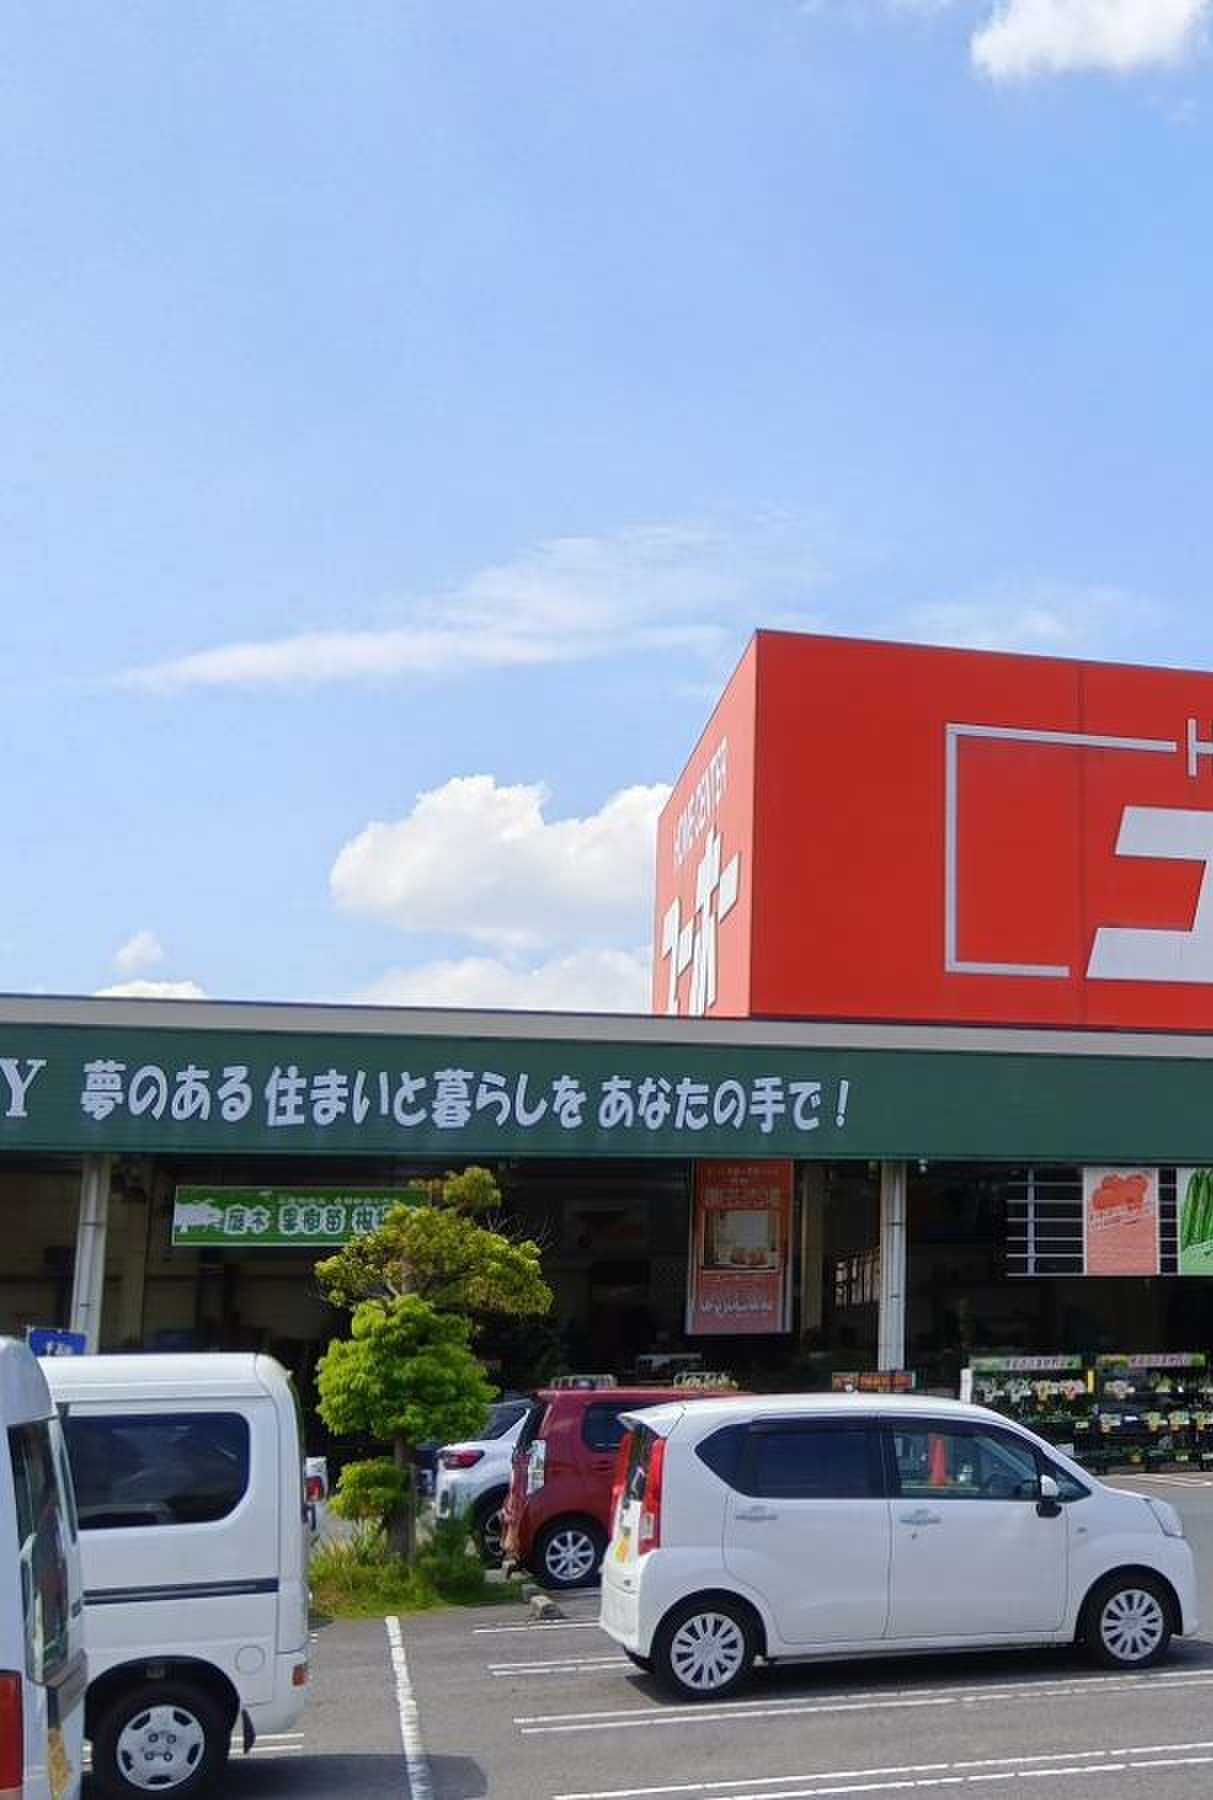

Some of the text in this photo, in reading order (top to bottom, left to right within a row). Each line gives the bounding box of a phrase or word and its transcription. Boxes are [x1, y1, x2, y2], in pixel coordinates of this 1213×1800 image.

[81, 1060, 253, 1122] 夢のある
[264, 1065, 587, 1130] 住まいと暮らしを
